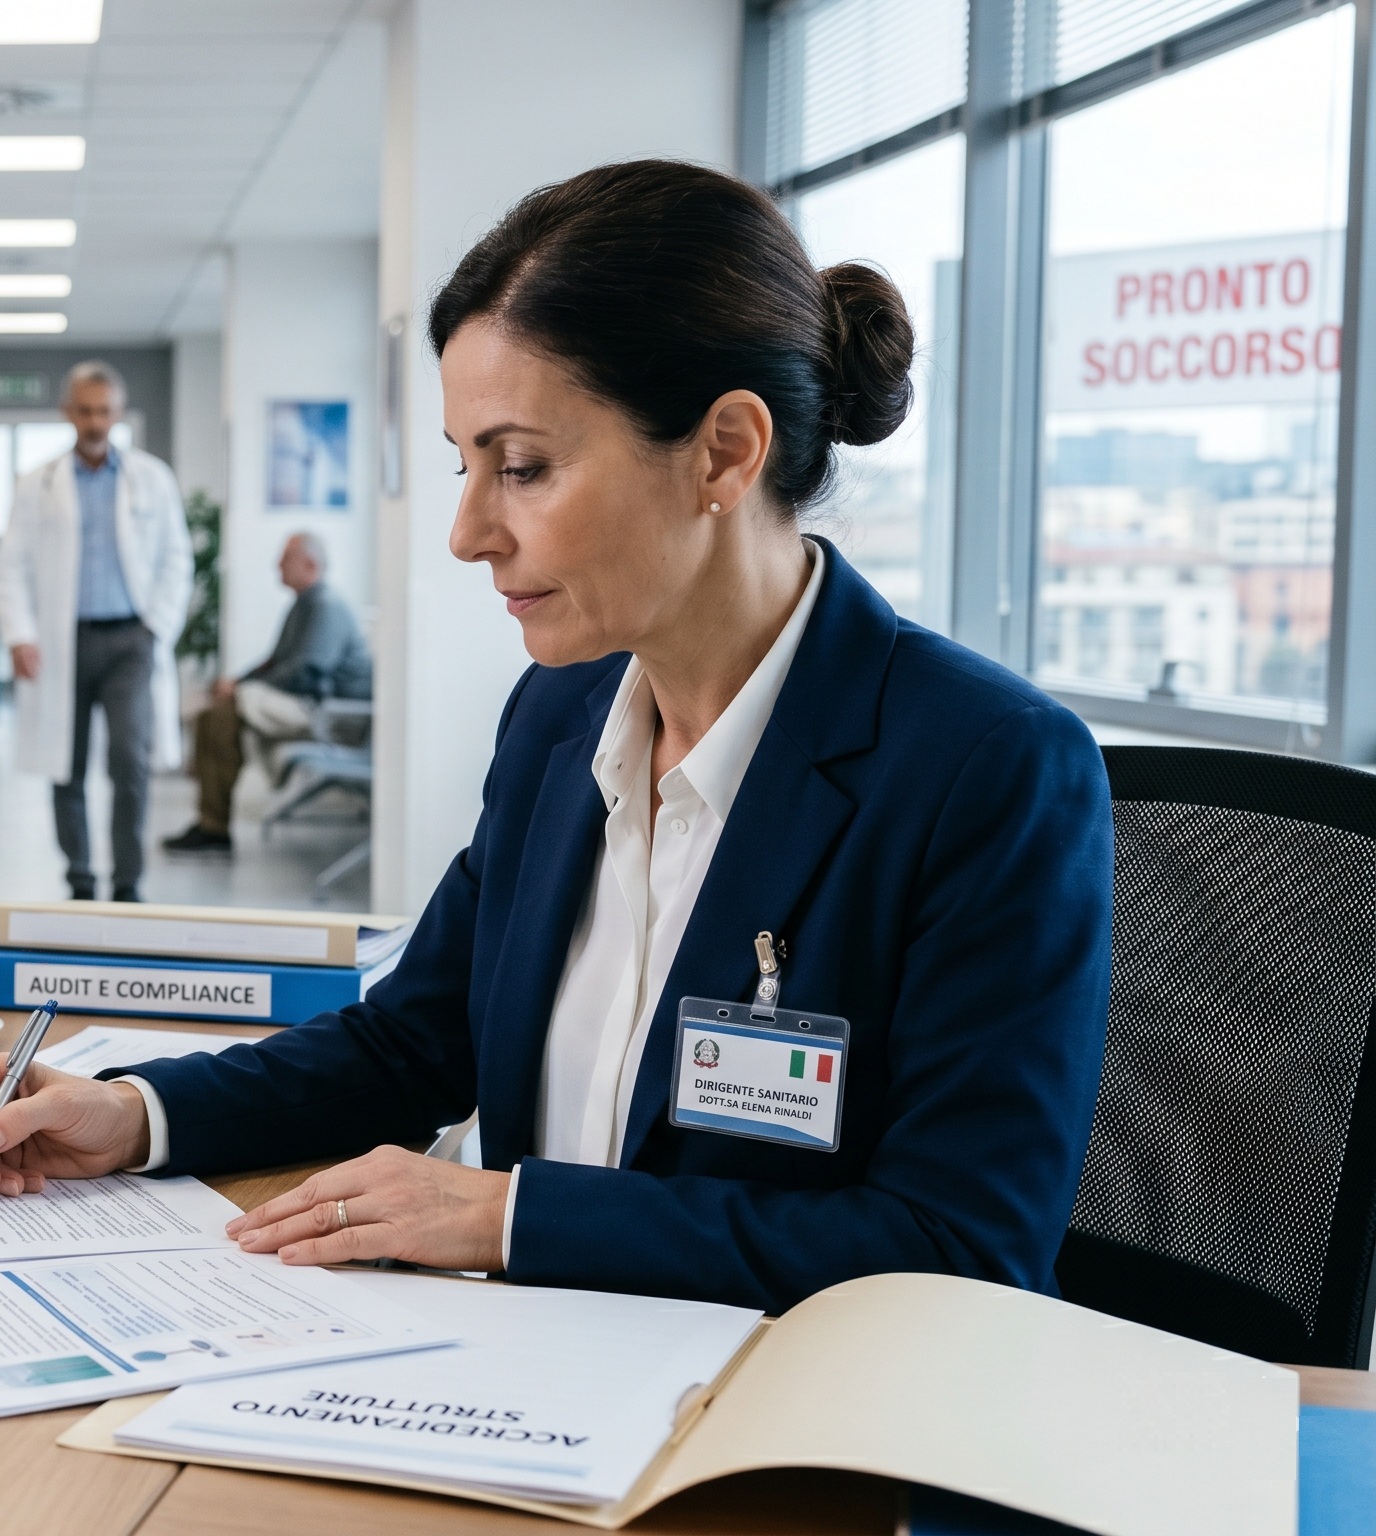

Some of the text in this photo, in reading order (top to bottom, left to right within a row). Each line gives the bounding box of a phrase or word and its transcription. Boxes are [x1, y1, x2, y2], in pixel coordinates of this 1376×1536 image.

[1115, 258, 1311, 319] PRONTO
[1082, 323, 1343, 388] SOCCORSO
[29, 976, 256, 1005] AUDIT E COMPLIANCE
[694, 1079, 818, 1107] DIRIGENTE SANITARIO
[698, 1095, 811, 1120] DOTT.SA ELENA RINALDI
[304, 1389, 525, 1422] STRUTTURE
[232, 1401, 589, 1447] ACCREDITAMENTO
